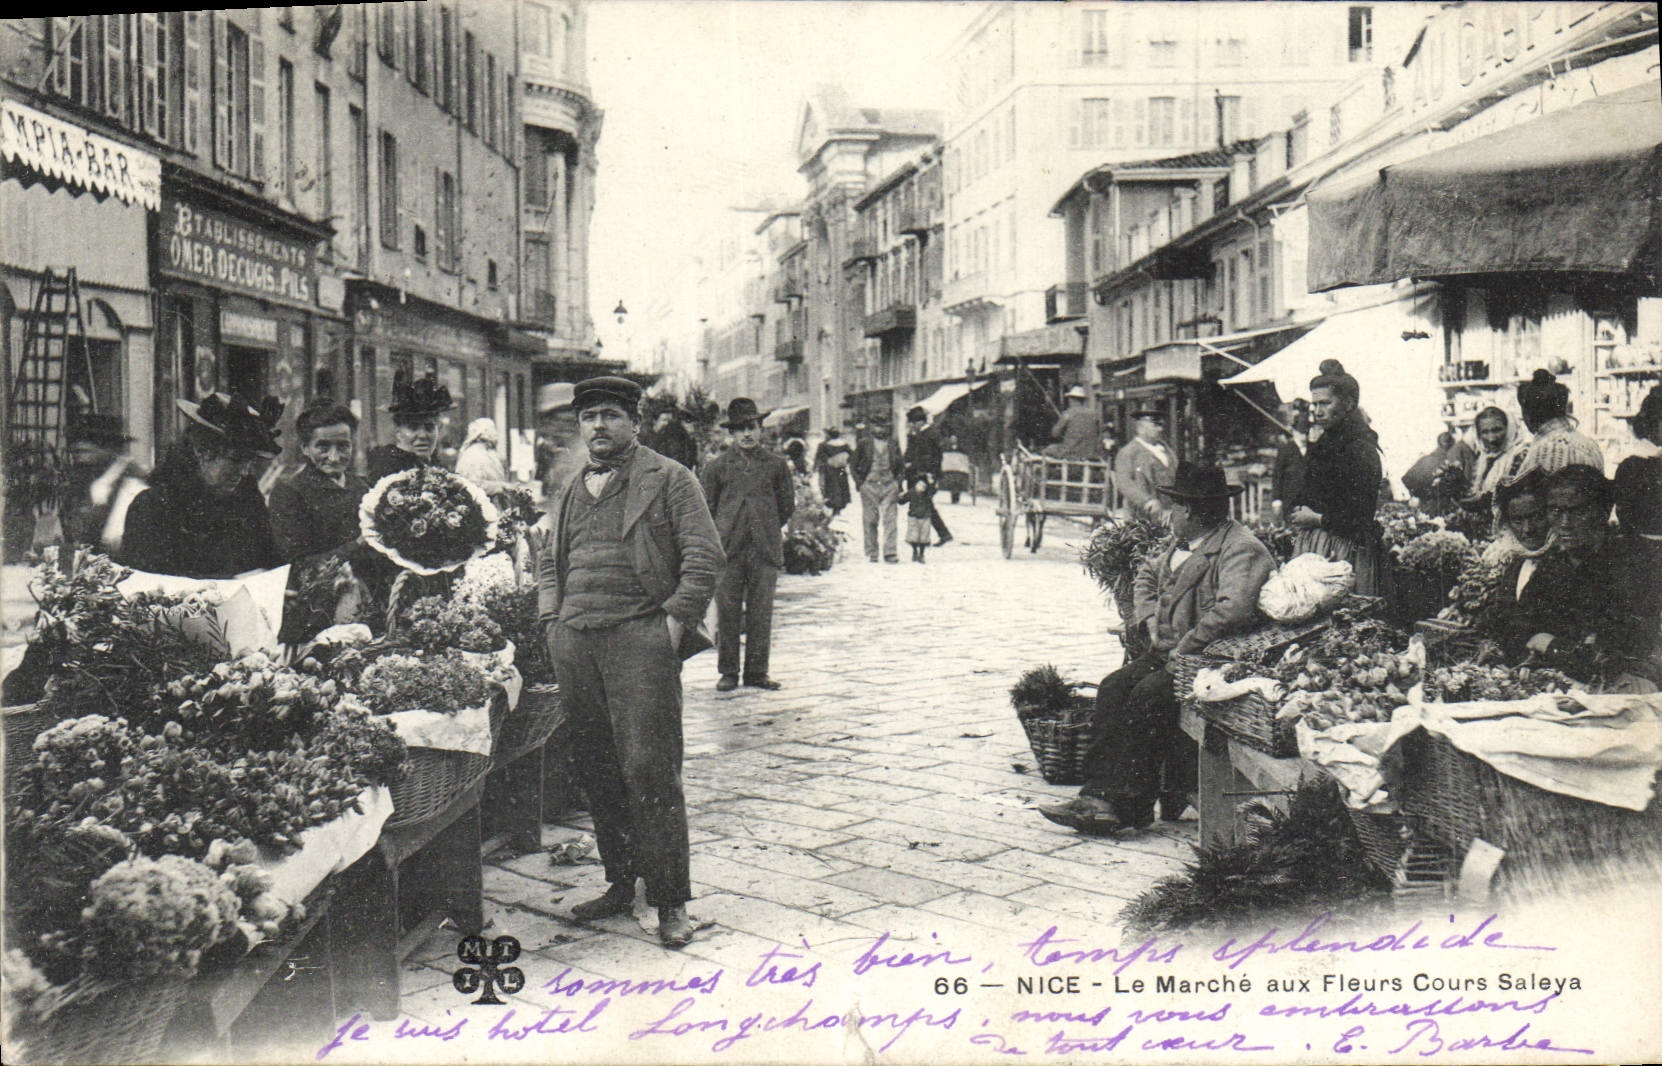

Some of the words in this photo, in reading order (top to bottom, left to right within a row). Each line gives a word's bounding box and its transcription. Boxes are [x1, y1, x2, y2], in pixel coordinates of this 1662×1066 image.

[170, 234, 215, 278] OMER
[541, 967, 724, 998] sommes
[746, 938, 822, 988] très
[1017, 925, 1183, 976] temps
[1213, 914, 1557, 971] splendide
[394, 1009, 468, 1041] suis
[1011, 1006, 1112, 1027] nous
[1127, 1003, 1232, 1024] vous
[1259, 991, 1562, 1020] embrassons
[1044, 1024, 1134, 1055] tout
